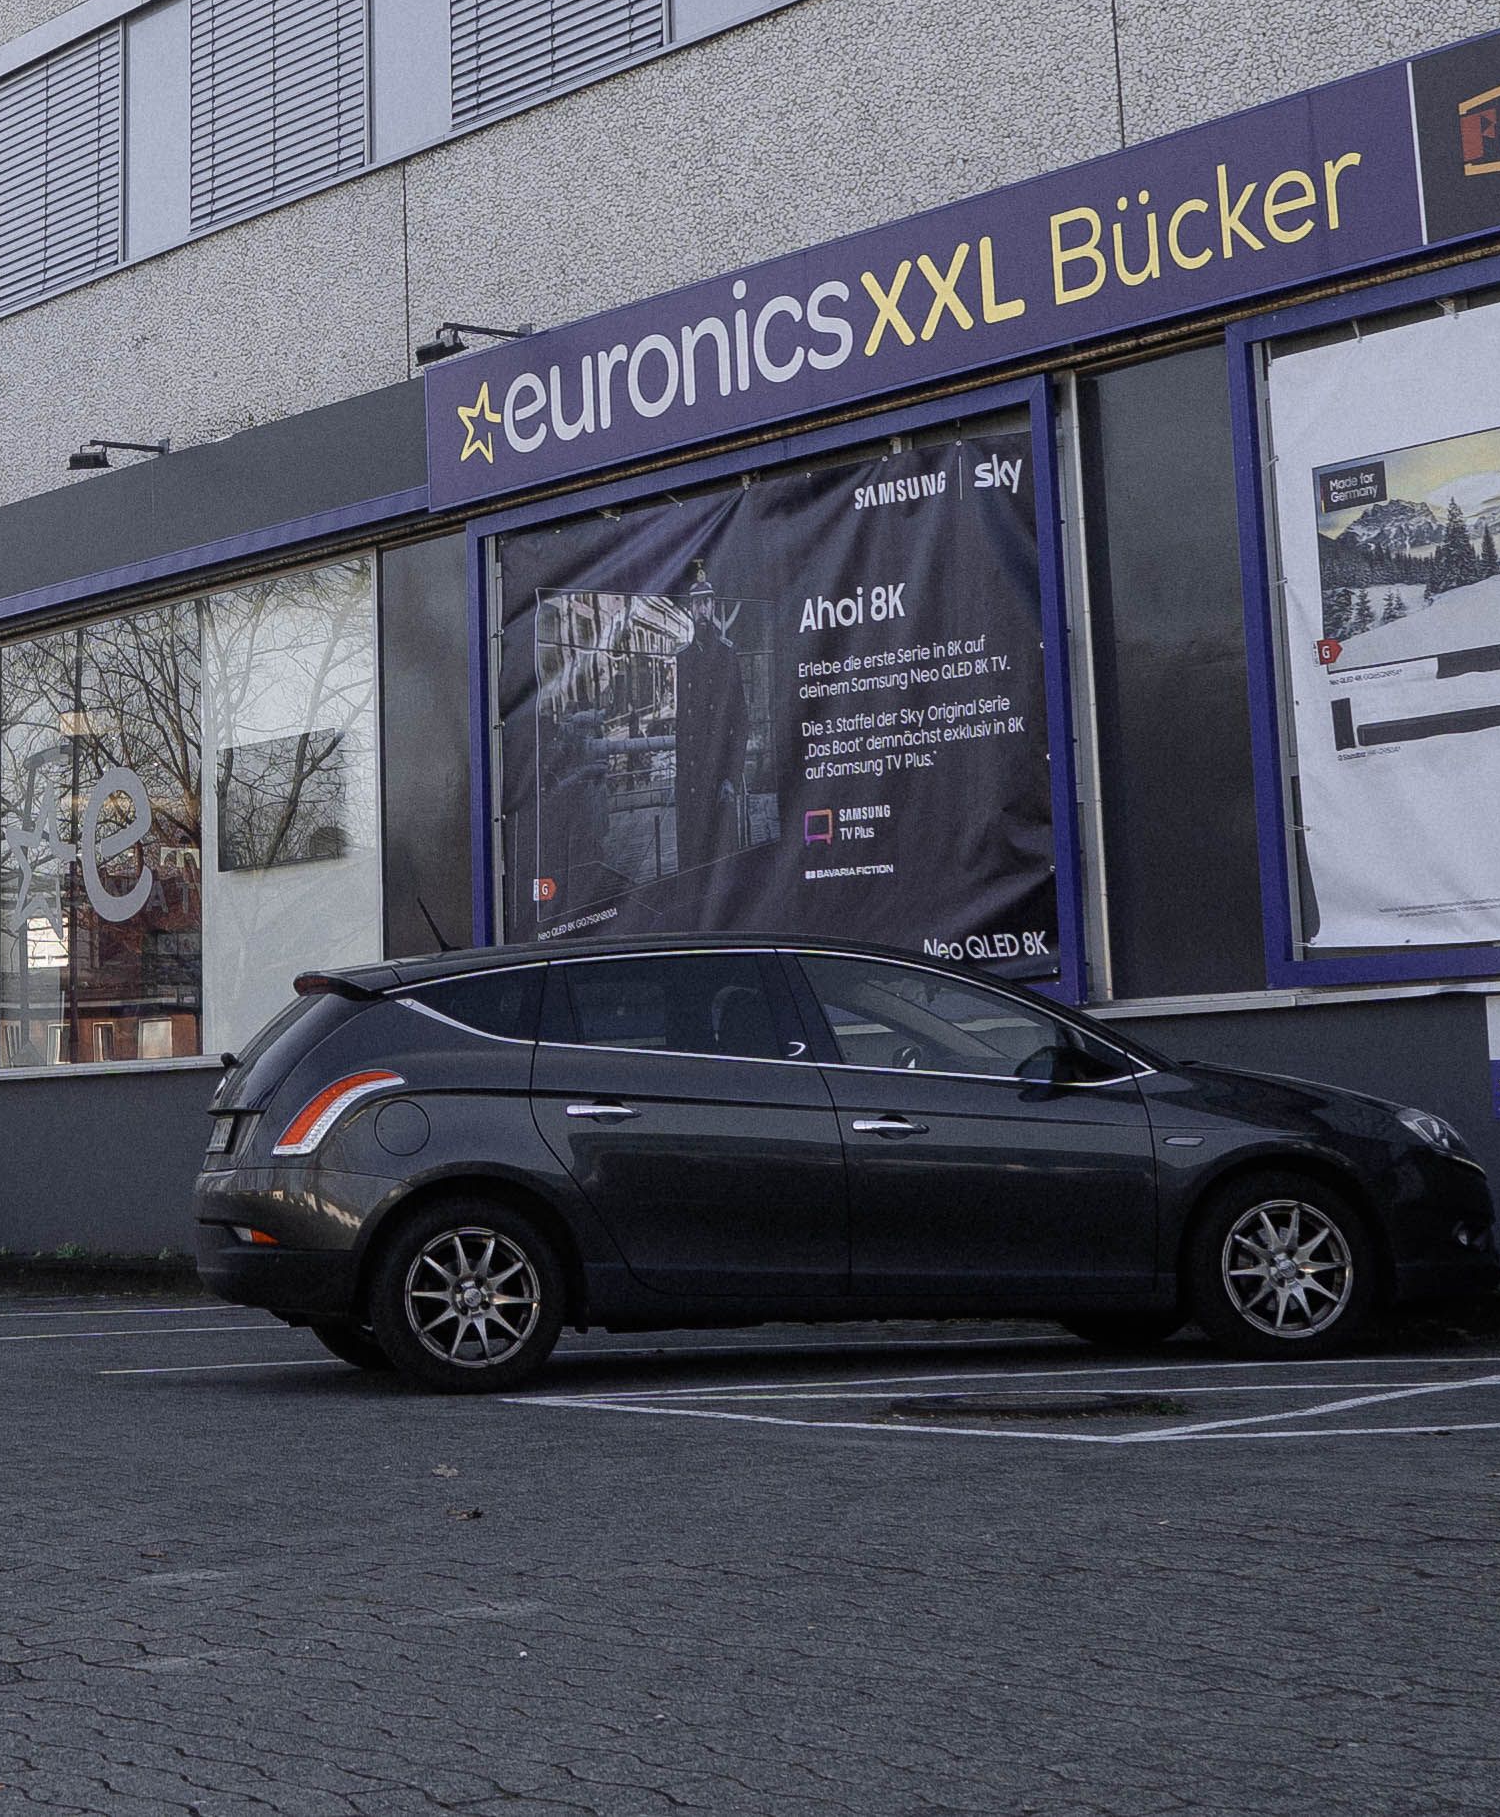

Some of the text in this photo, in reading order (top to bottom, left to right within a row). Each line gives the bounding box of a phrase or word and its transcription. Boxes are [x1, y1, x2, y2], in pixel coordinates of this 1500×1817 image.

[1049, 152, 1362, 306] Bücker
[854, 471, 946, 510] SAMSUNG
[974, 453, 1022, 493] sky
[1329, 472, 1375, 491] Made for
[1331, 485, 1378, 503] Germany
[800, 583, 906, 632] Ahoi 8K
[798, 634, 986, 677] Erlebe die erste Serie in 8K auf
[799, 655, 1011, 699] deinem Samsung Neo QLED 8K TV.
[802, 695, 1010, 737] Die 3. Staffel der Sky Original Serie
[866, 728, 942, 751] demnächst
[943, 723, 992, 742] exklusiv
[993, 719, 1006, 734] in
[1008, 716, 1025, 733] 8K
[805, 763, 825, 780] auf
[826, 757, 883, 777] Samsung
[885, 755, 901, 770] TV
[839, 805, 891, 822] SAMSUNG
[840, 826, 875, 840] TV Plus
[542, 884, 548, 895] G
[924, 930, 1050, 961] Neo QLED 8K
